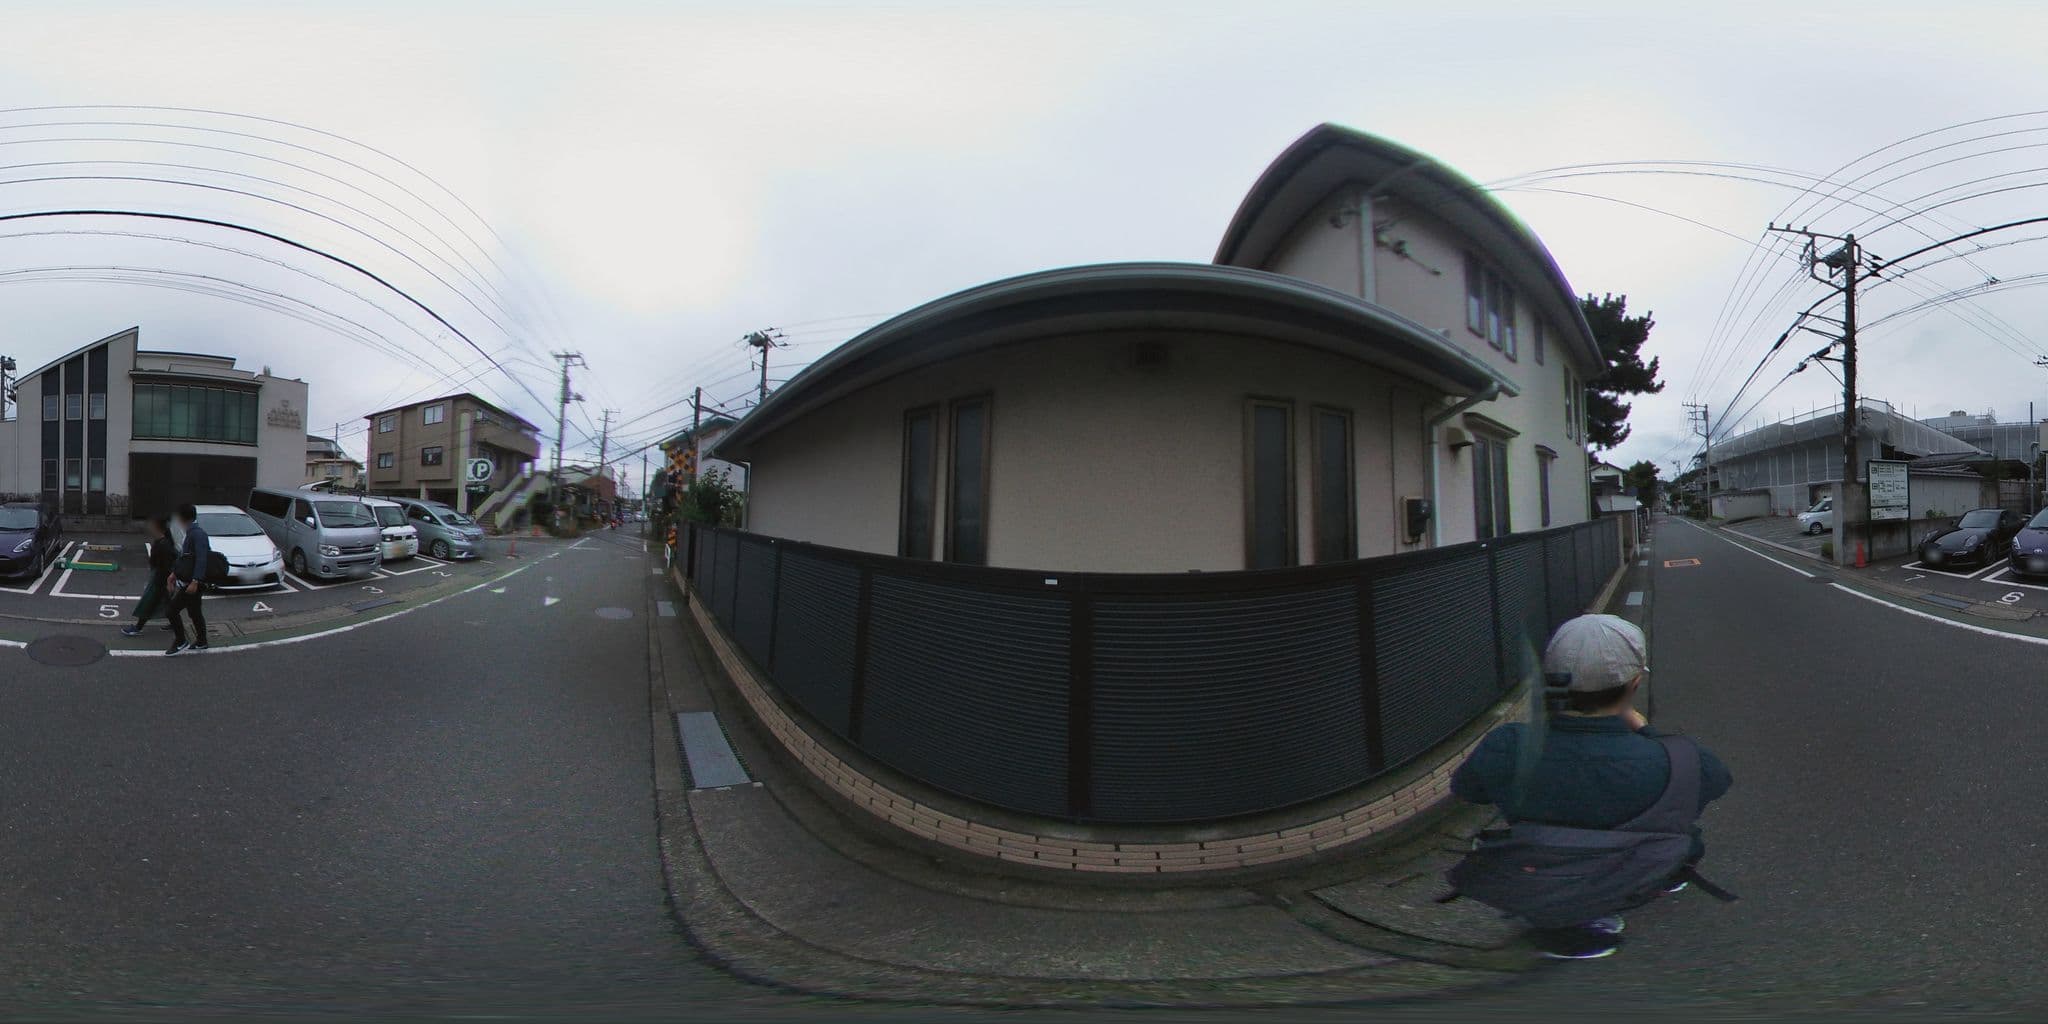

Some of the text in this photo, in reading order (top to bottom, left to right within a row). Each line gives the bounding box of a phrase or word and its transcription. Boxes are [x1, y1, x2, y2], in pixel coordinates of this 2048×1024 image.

[477, 463, 488, 477] P
[362, 586, 383, 594] 3
[2002, 591, 2024, 603] 6
[99, 604, 120, 619] 5
[252, 601, 273, 613] 4
